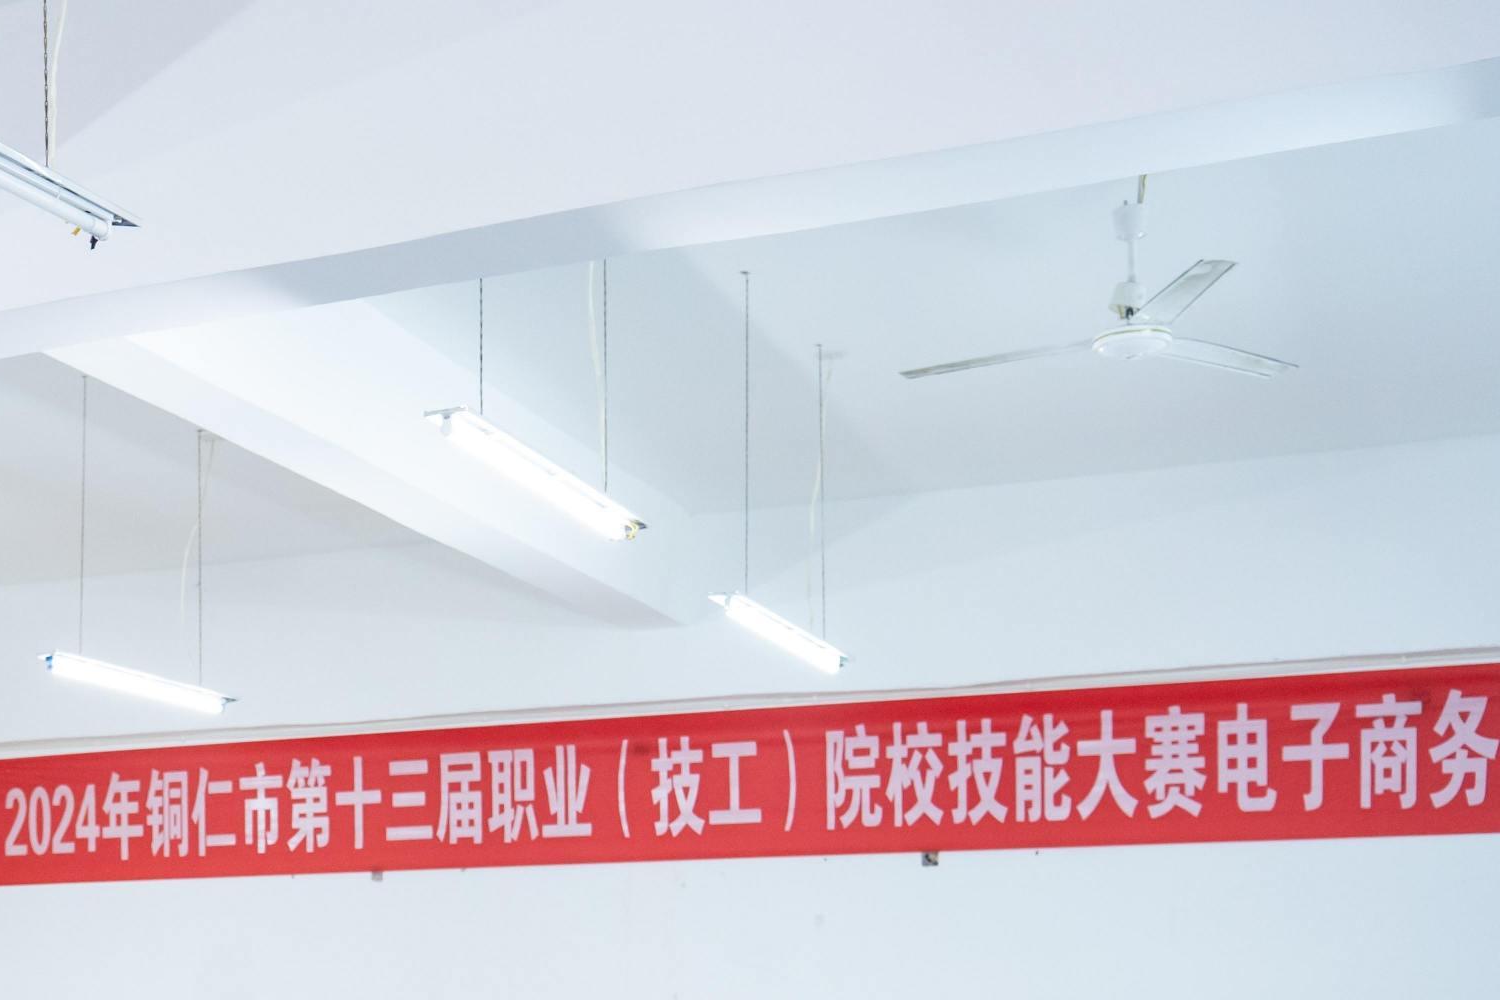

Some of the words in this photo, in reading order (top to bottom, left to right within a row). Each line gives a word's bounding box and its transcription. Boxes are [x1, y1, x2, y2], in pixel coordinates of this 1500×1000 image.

[4, 688, 1500, 861] 2024年铜仁市第十三届职业（技工）院校技能大赛电子商务
